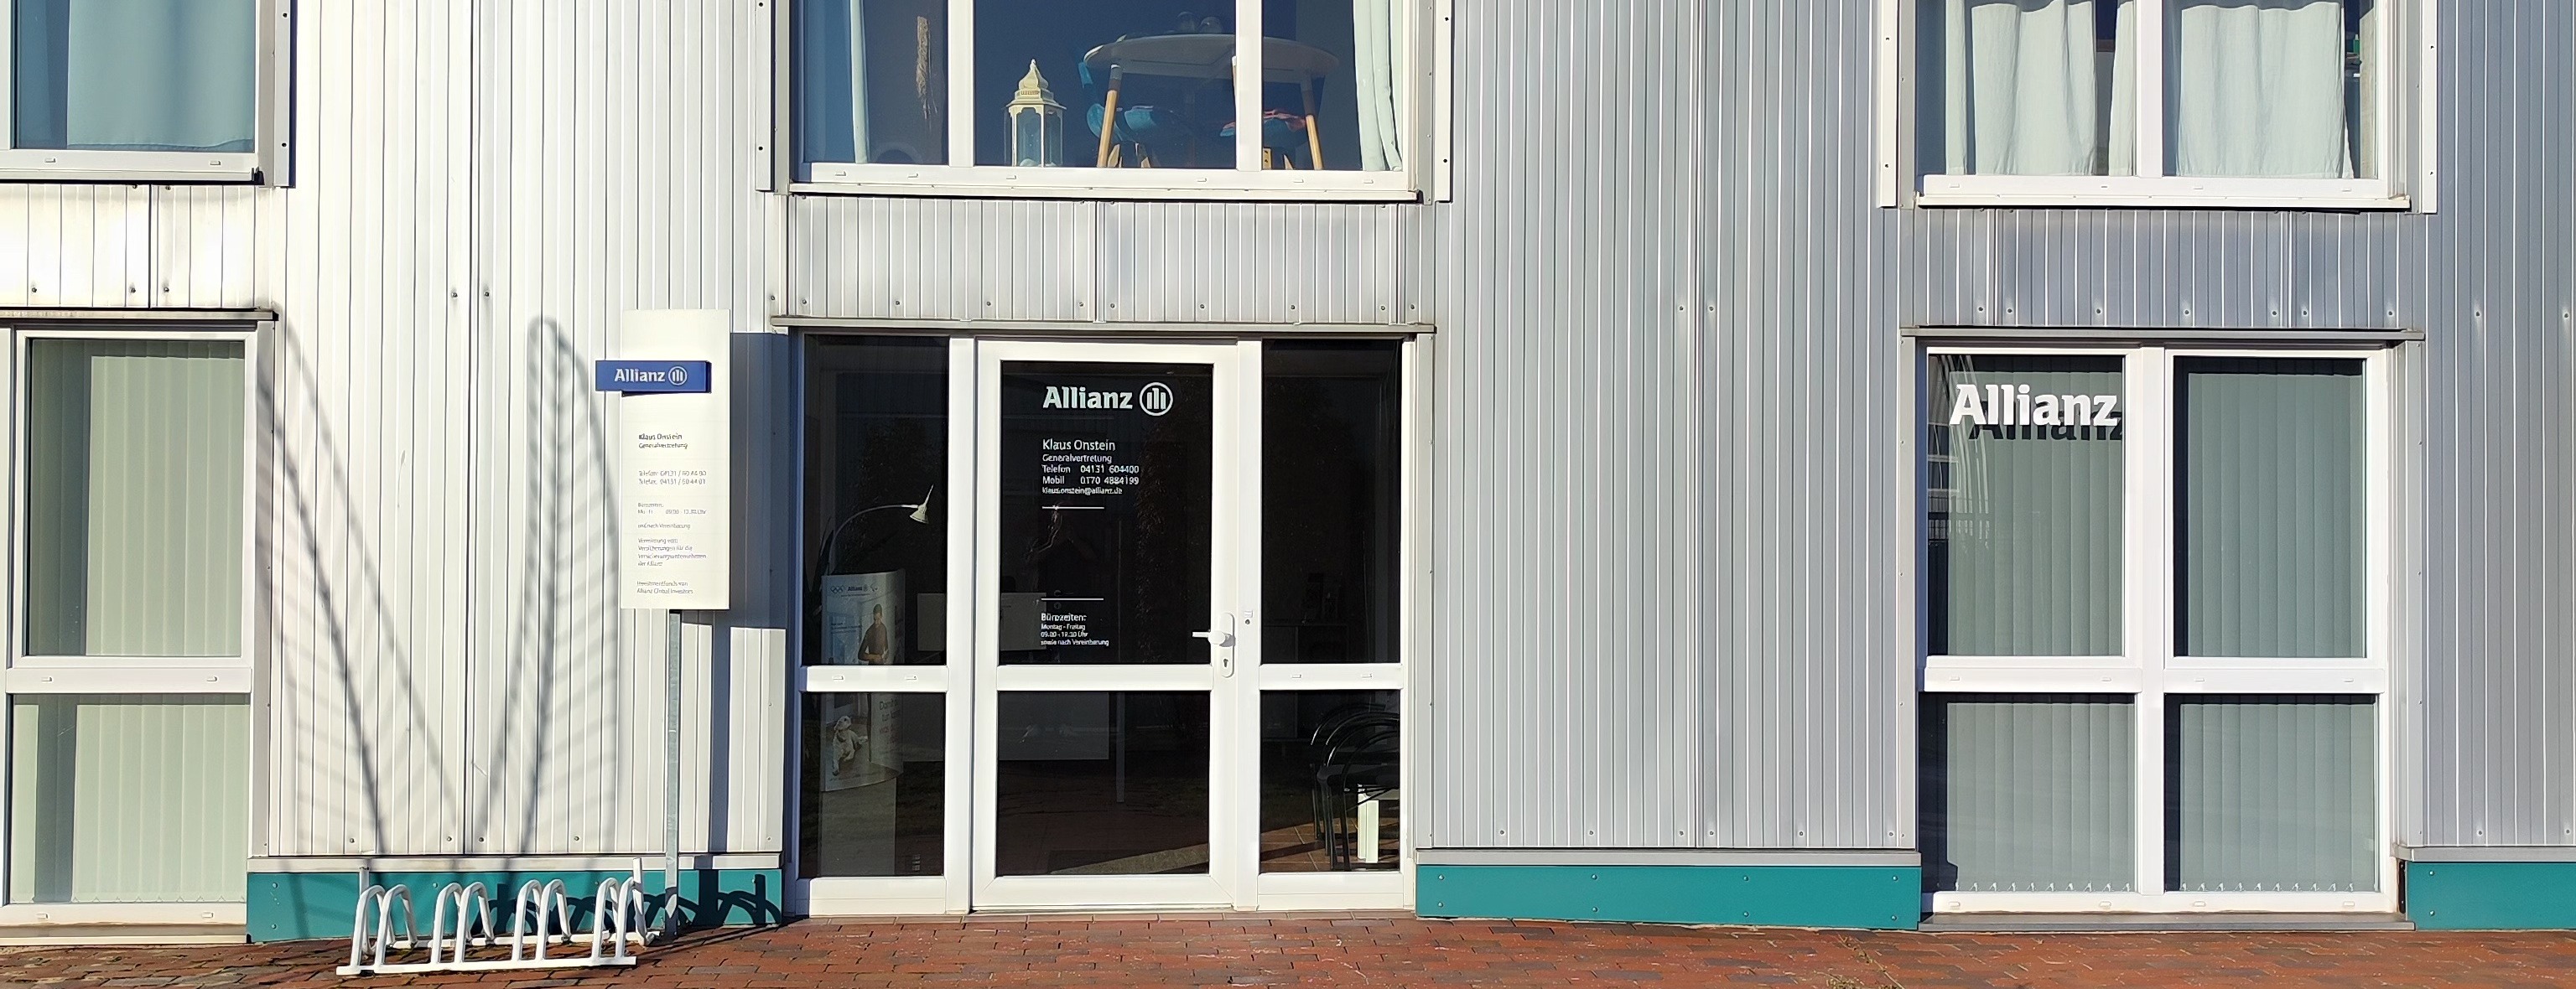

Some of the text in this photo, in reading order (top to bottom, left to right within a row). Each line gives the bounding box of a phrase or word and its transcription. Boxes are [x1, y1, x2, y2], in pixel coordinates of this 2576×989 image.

[614, 368, 666, 382] Allianz
[1042, 386, 1133, 409] Allianz
[1949, 384, 2118, 426] Allianz
[1042, 438, 1116, 451] Klaus Onstein
[1042, 453, 1112, 463] Generalvertretung
[1041, 464, 1140, 474] Telefon 04131 604400
[1042, 475, 1064, 484] Mobil
[1080, 476, 1101, 484] 0170
[1041, 613, 1087, 622] Bürozeiten:
[1072, 638, 1109, 646] Vereinbarung
